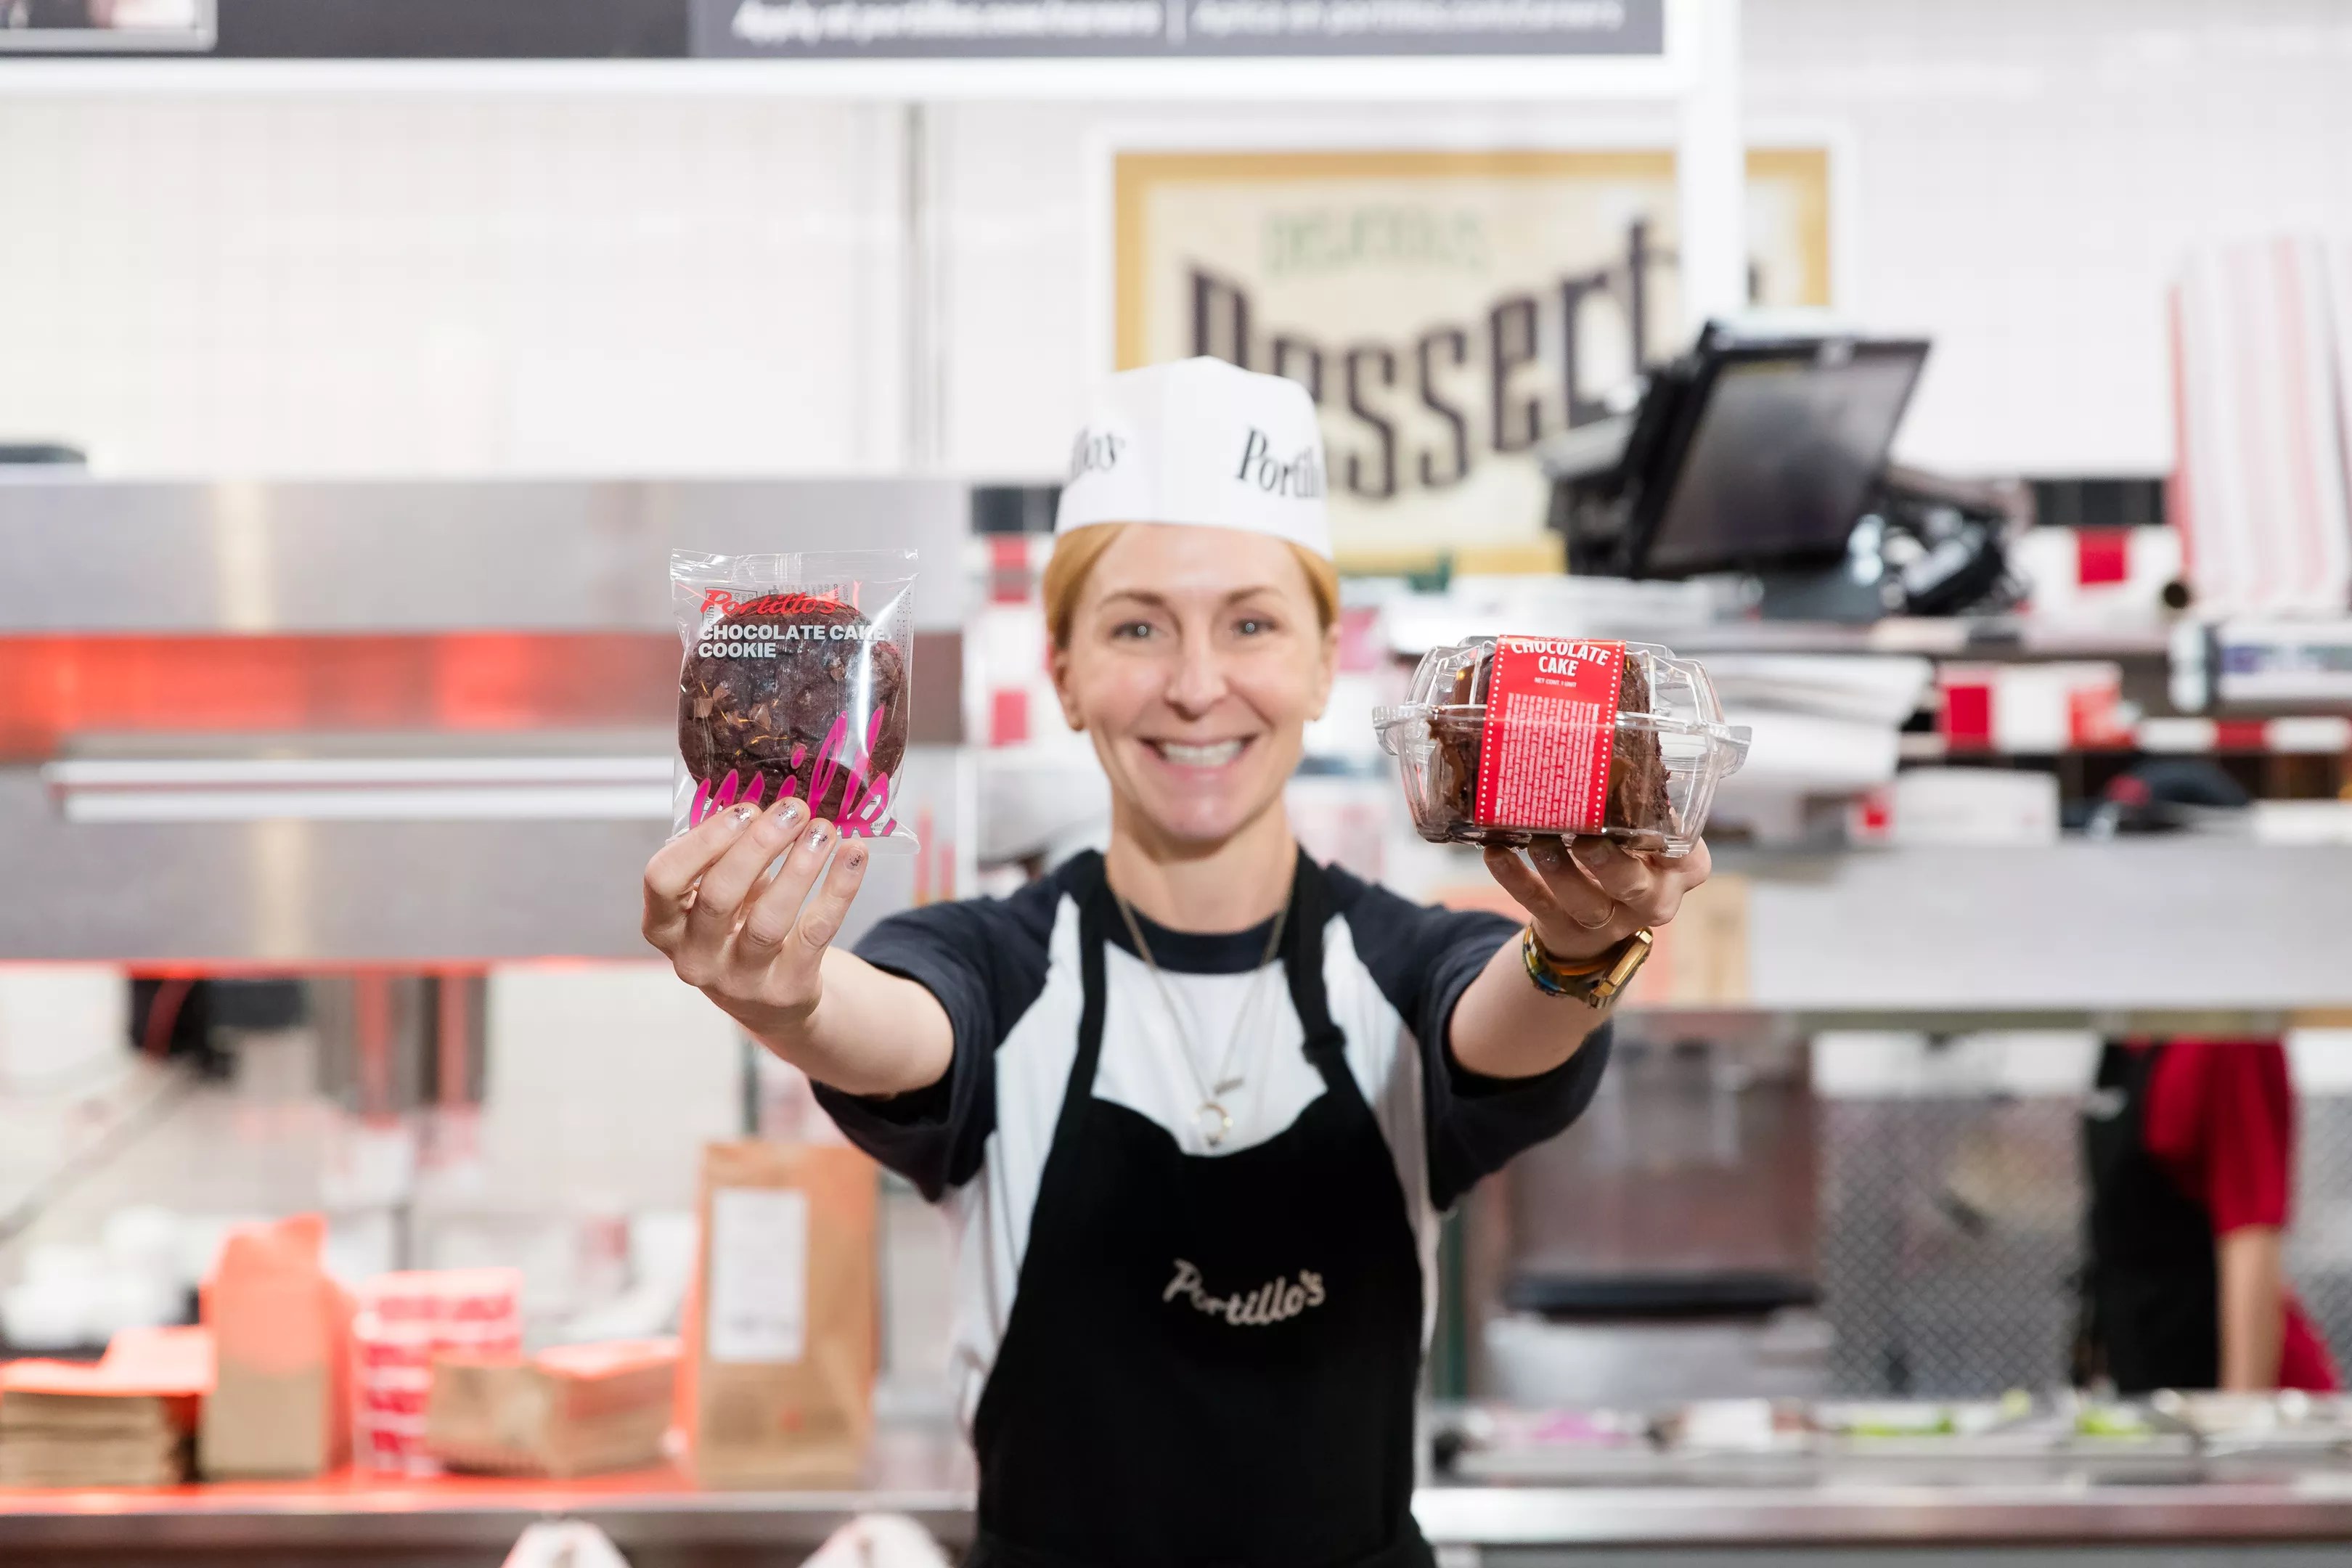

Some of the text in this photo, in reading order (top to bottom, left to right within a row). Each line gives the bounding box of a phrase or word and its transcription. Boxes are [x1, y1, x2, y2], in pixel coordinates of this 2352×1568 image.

[700, 589, 836, 616] Portillos
[700, 624, 886, 641] CHOCOLATE CAKE
[698, 642, 777, 658] COOKIE
[1510, 641, 1612, 666] CHOCOLATE
[1538, 656, 1579, 677] CAKE
[1162, 1257, 1326, 1326] Portillo's
